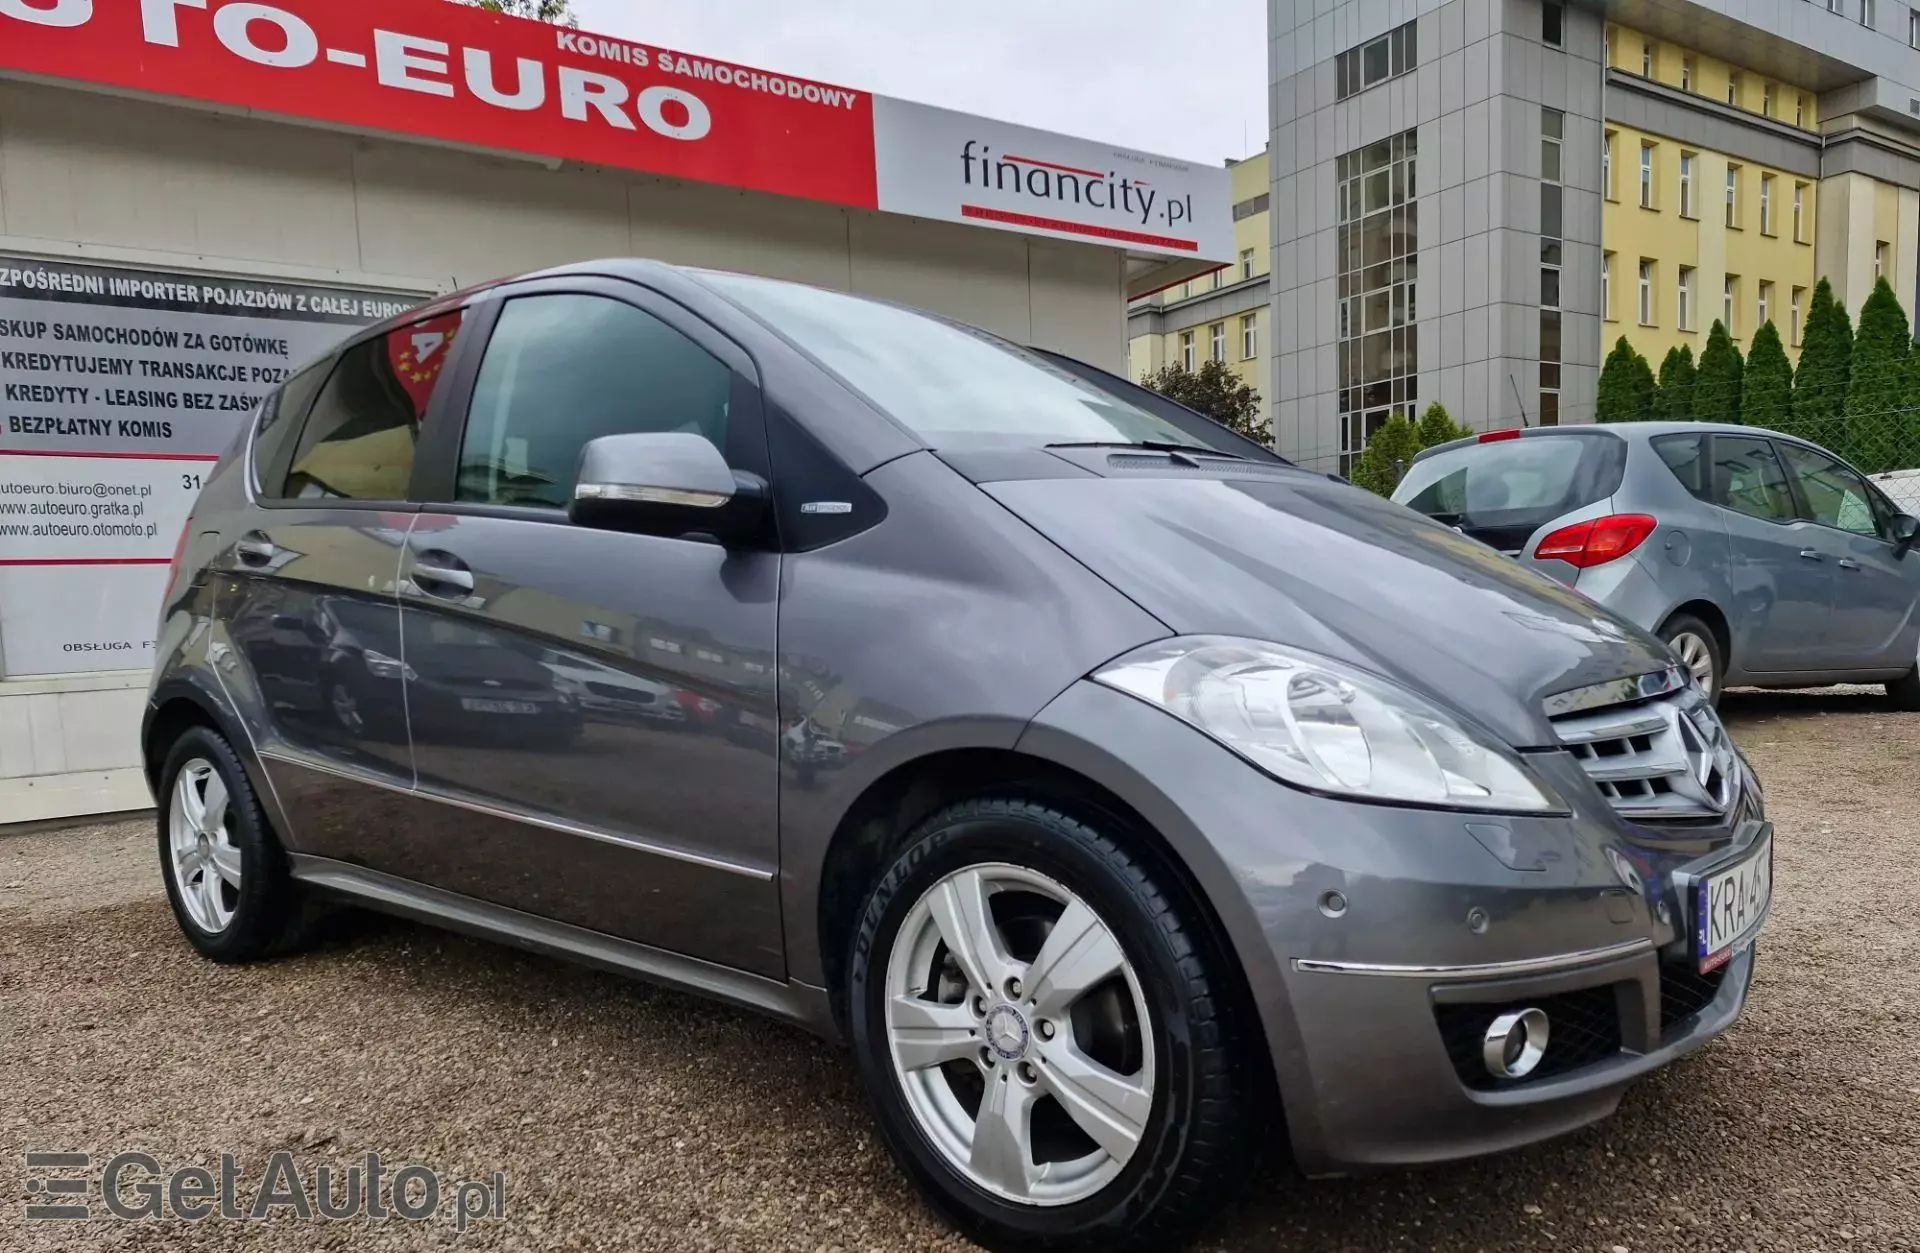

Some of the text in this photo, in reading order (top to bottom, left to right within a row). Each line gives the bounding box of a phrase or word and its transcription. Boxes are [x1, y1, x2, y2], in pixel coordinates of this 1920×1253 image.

[556, 31, 857, 110] KOMIS SAMOCHODOWY
[960, 140, 1193, 227] financity.pl
[109, 278, 199, 303] IMPORTER
[203, 286, 292, 311] POJAZDÓW
[296, 294, 308, 312] Z
[310, 296, 359, 316] CAŁEJ
[0, 319, 289, 360] SKUP SAMOCHODÓW ZA GOTÓWKĘ
[2, 351, 133, 376] KREDYTUJEMY
[139, 360, 248, 382] TRANSAKCJE
[6, 383, 88, 404] KREDYTY
[105, 388, 178, 409] LEASING
[182, 392, 215, 411] BEZ
[9, 415, 173, 439] BEZPŁATNY KOMIS
[63, 640, 133, 653] OBSŁUGA
[1710, 868, 1746, 946] KRA
